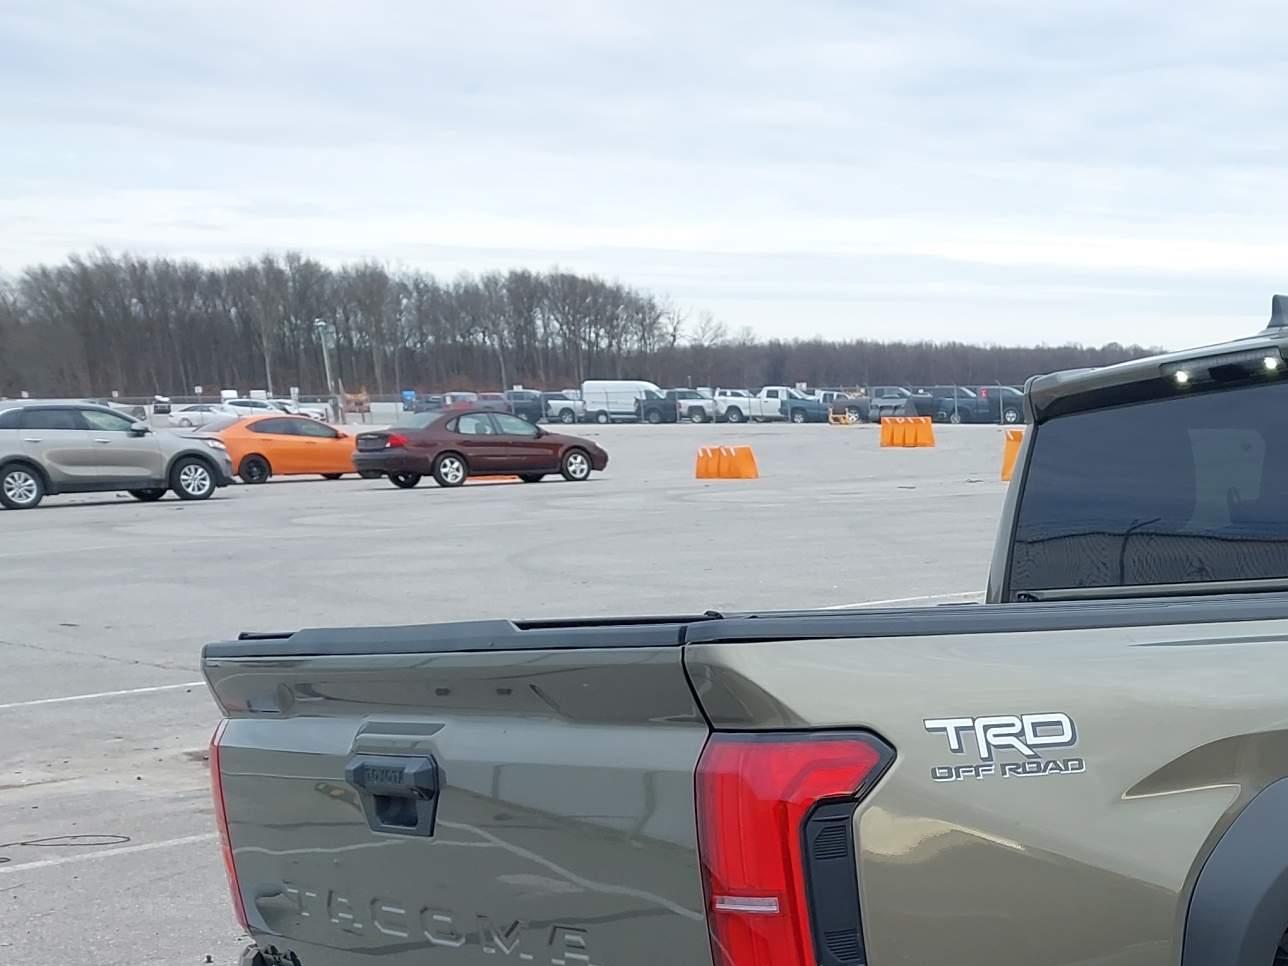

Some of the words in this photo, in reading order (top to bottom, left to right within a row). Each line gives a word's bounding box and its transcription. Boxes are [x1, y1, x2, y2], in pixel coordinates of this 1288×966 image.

[923, 712, 1078, 762] TRD
[931, 763, 996, 783] OFF
[1000, 757, 1087, 779] ROAD
